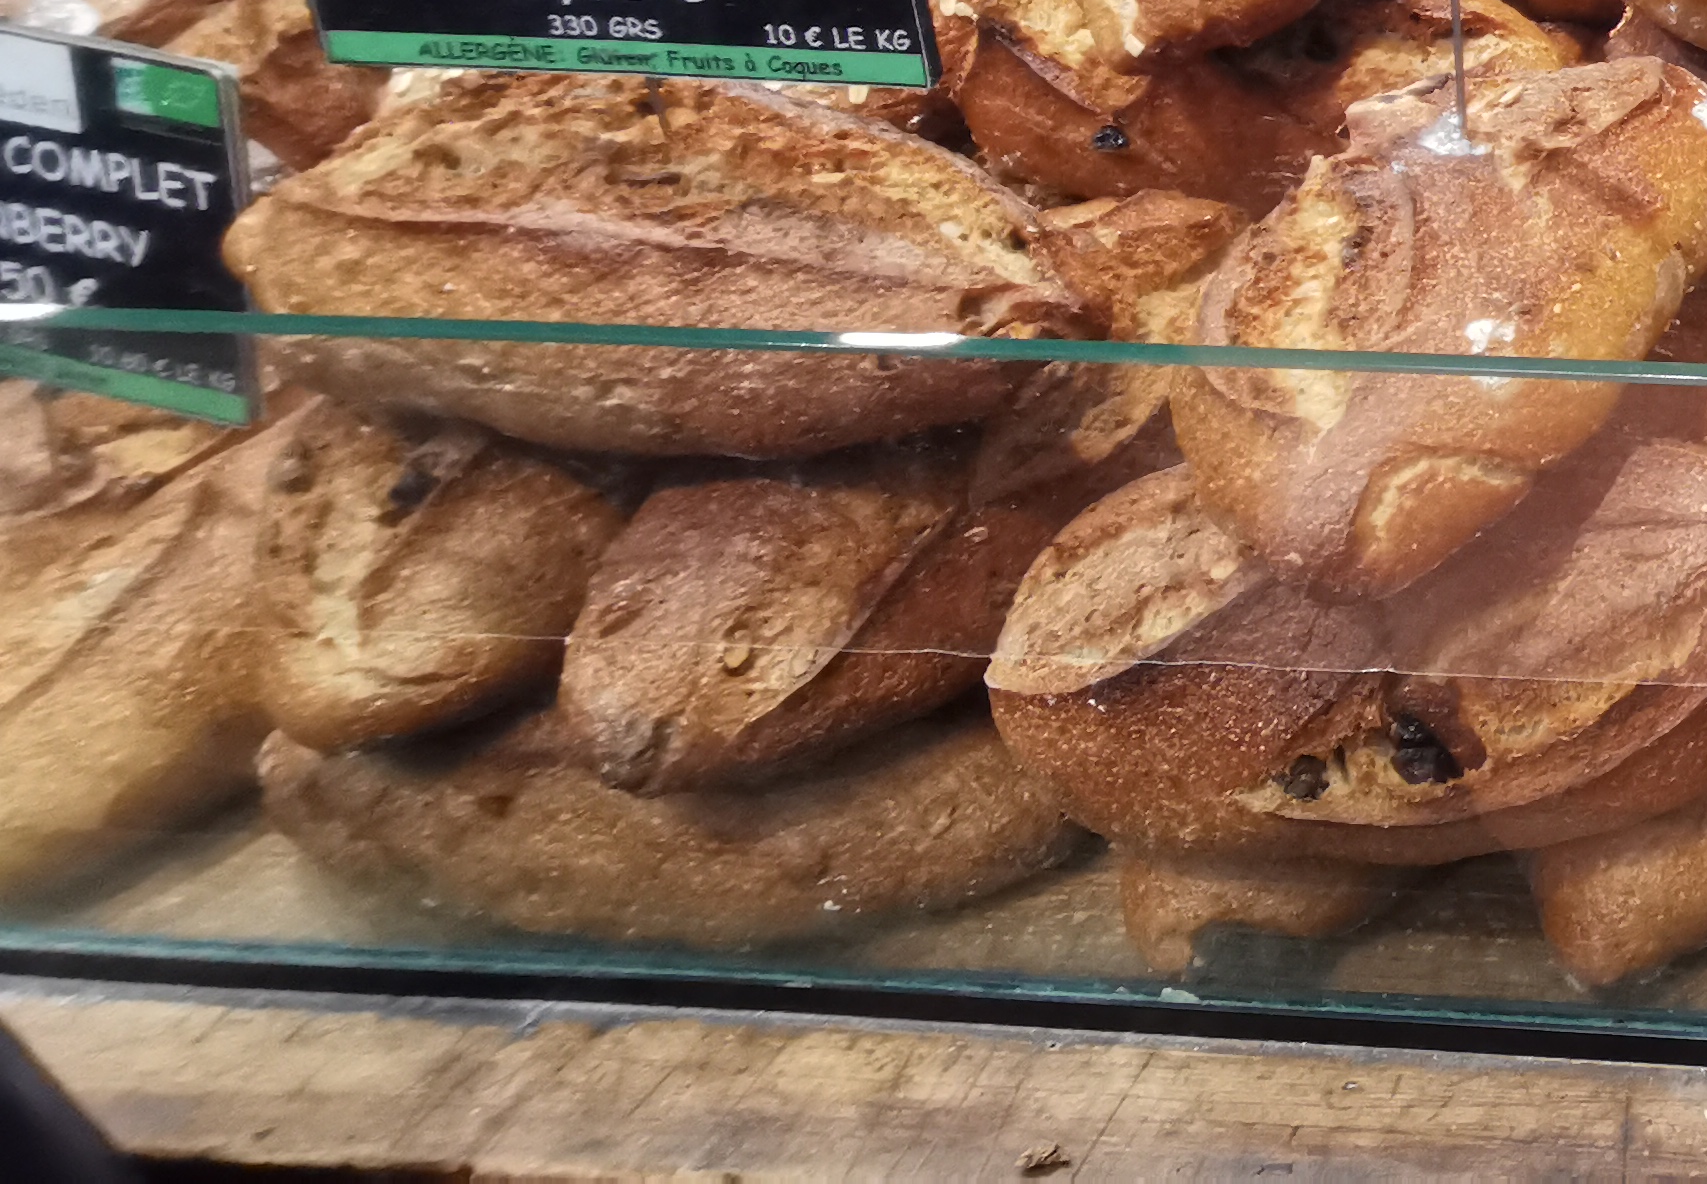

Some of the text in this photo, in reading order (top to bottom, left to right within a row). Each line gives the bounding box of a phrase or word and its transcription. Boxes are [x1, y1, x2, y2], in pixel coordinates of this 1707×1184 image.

[548, 15, 664, 40] 330 GRS
[763, 24, 911, 51] 10 € LE KG
[667, 49, 734, 72] Fruits
[743, 52, 757, 73] à
[767, 54, 843, 81] Coques
[4, 136, 216, 211] COMPLET
[0, 201, 149, 267] BERRY
